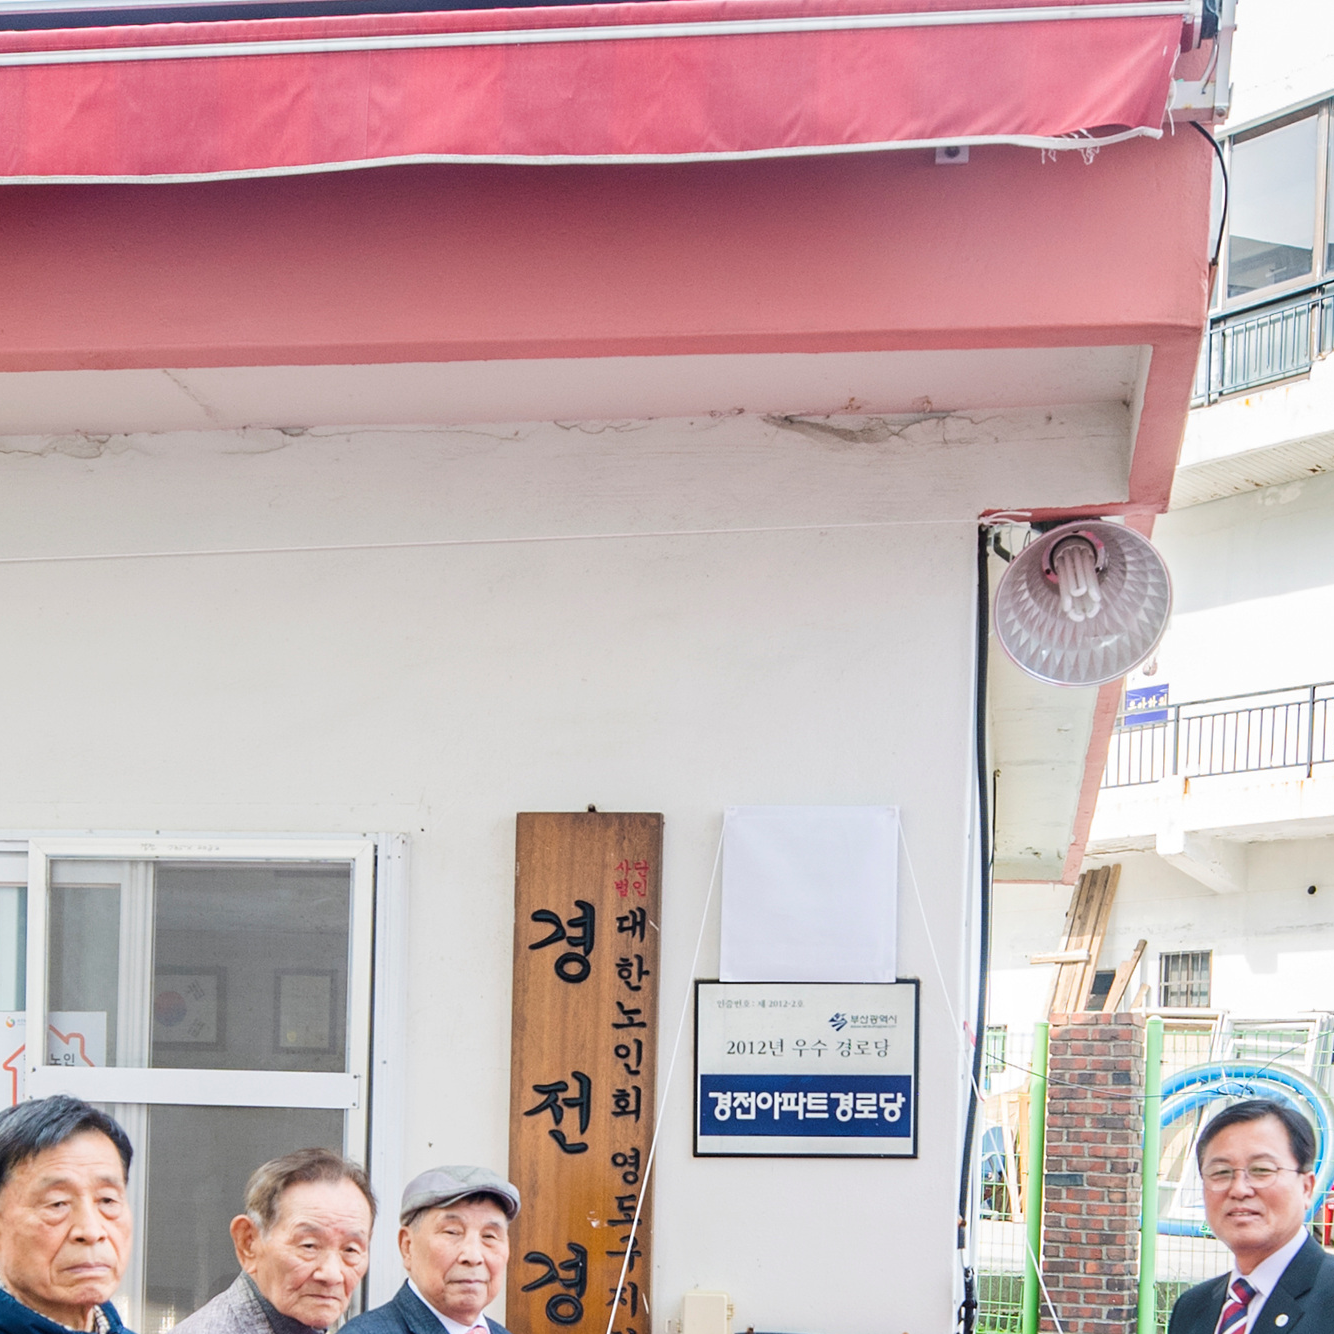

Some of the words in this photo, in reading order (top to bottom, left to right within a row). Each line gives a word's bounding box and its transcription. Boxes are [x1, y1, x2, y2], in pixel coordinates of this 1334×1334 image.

[850, 1014, 898, 1025] 부산광역시
[726, 1039, 785, 1057] 2012년
[792, 1039, 829, 1058] 우수
[835, 1038, 892, 1058] 경로당
